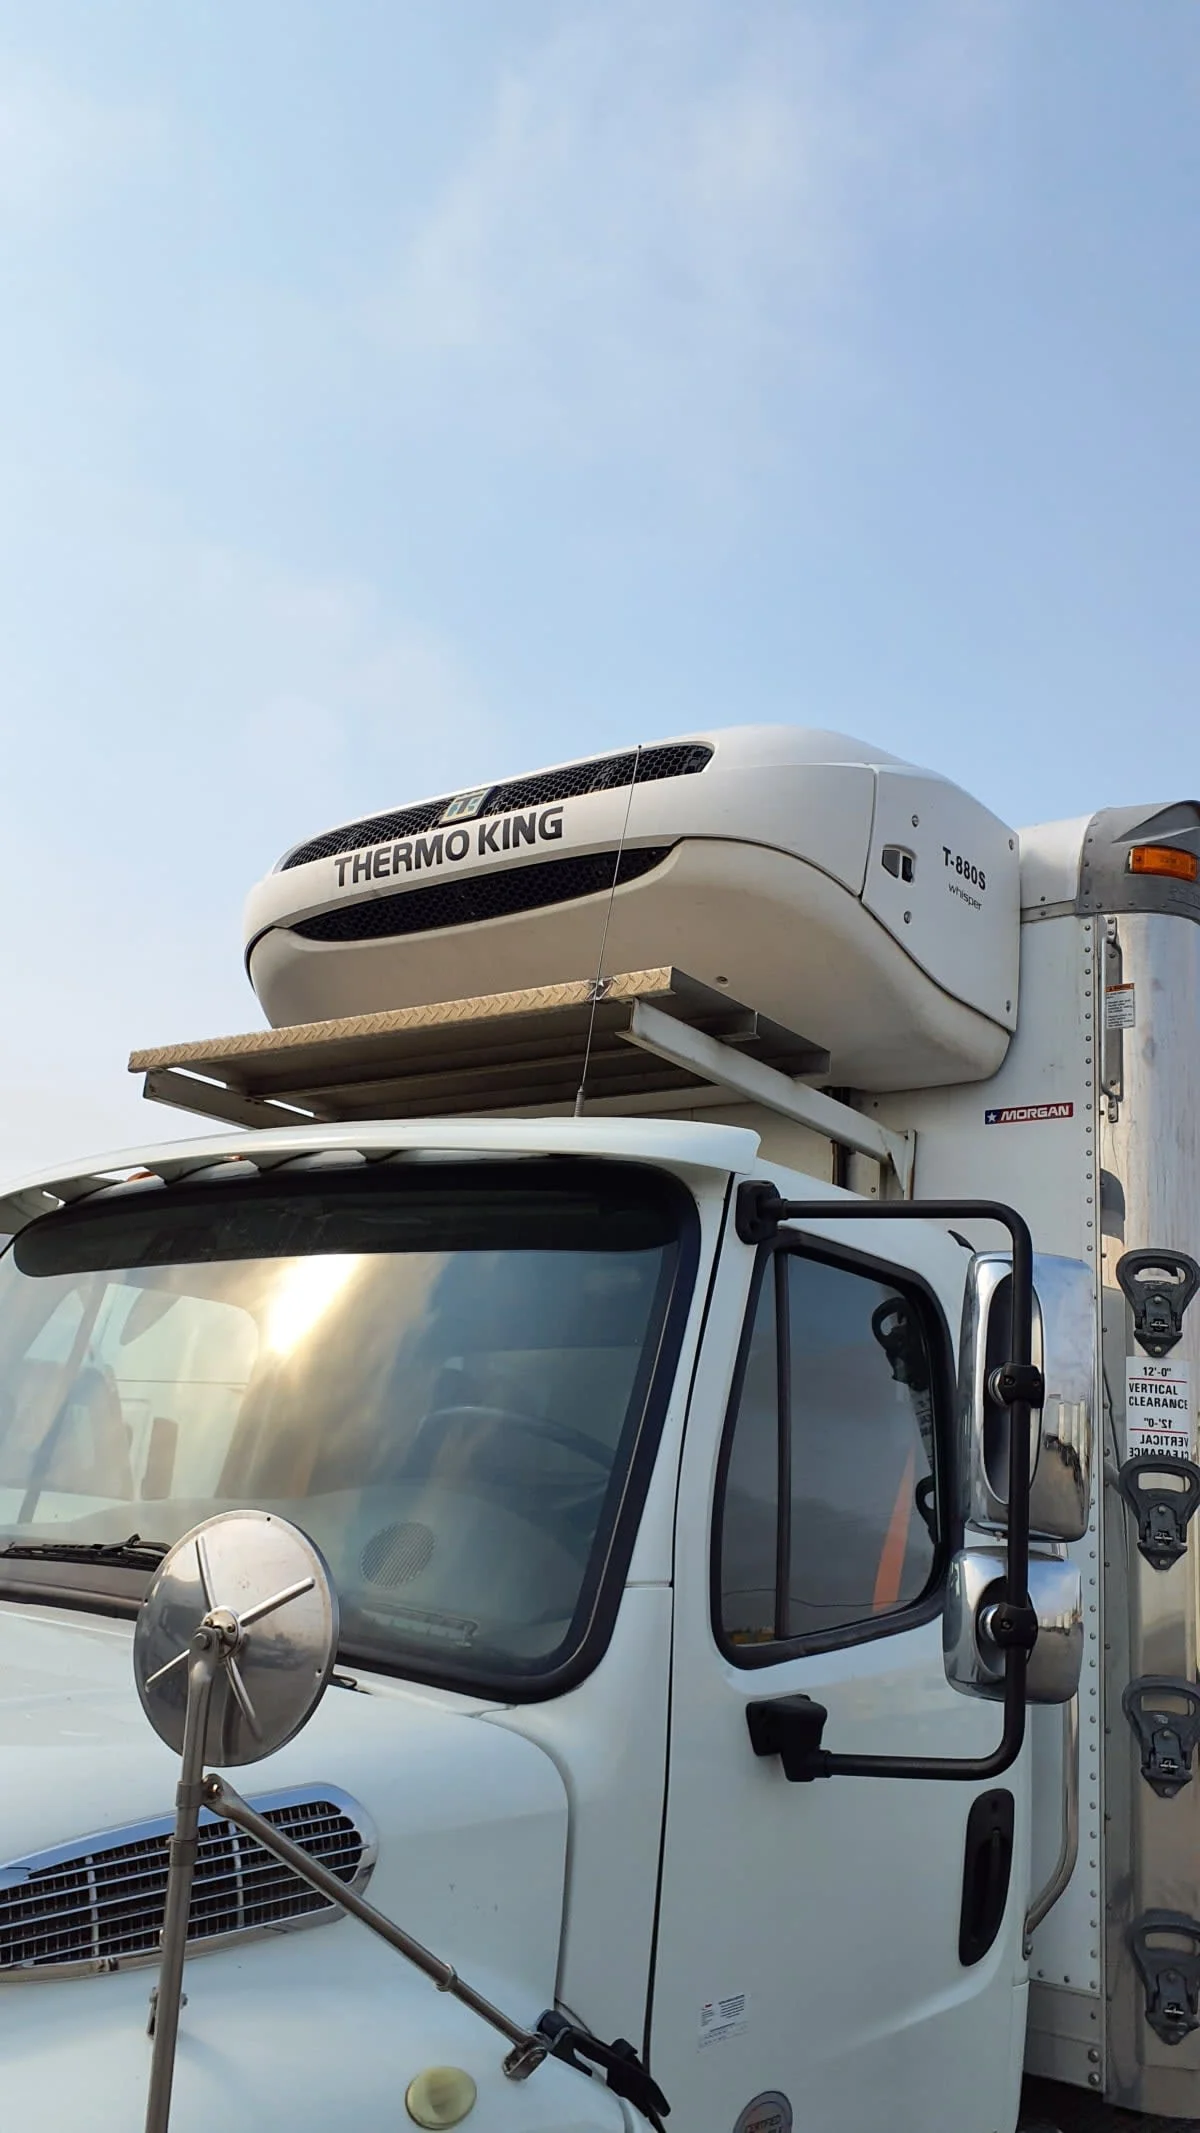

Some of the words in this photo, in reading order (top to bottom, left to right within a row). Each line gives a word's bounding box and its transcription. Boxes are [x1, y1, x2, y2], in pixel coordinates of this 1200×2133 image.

[334, 830, 470, 887] THERMO
[478, 806, 564, 856] KING
[942, 846, 987, 891] T-880S
[948, 882, 983, 911] whisper
[1000, 1104, 1070, 1122] MORGAN
[1143, 1366, 1172, 1377] 12'-0"
[1128, 1382, 1179, 1395] VERTICAL
[1128, 1396, 1189, 1410] CLEARANCE
